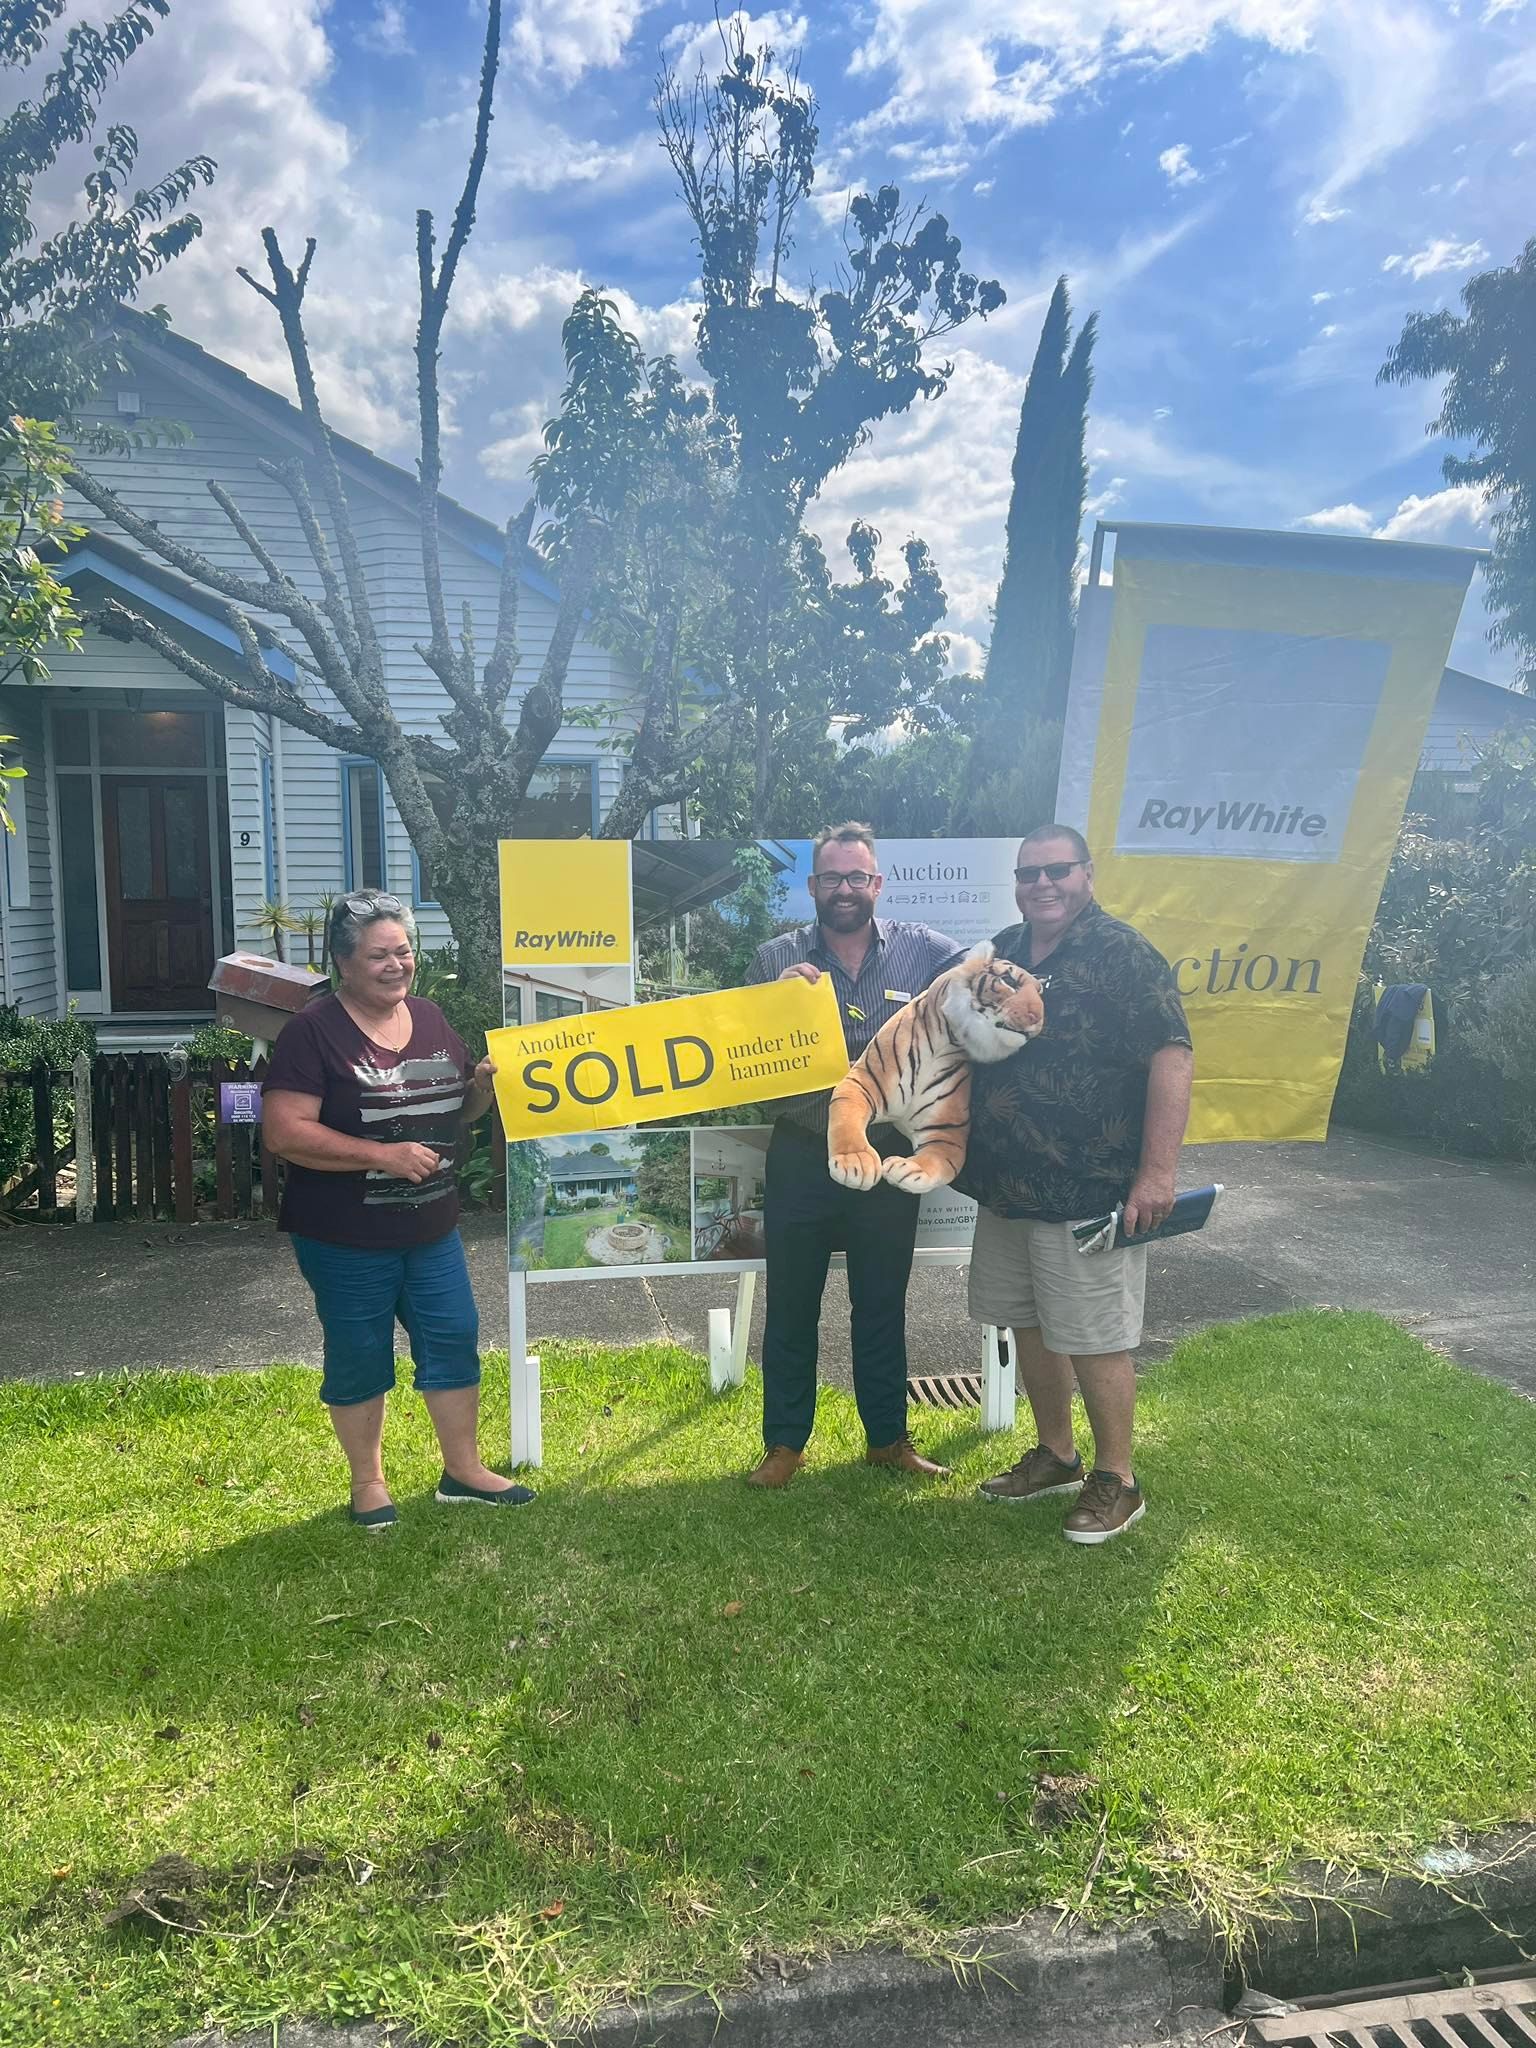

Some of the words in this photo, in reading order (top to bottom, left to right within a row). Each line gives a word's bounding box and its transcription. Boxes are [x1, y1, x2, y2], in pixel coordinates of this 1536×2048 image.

[1138, 799, 1327, 837] RayWhite
[240, 832, 250, 846] 9
[887, 862, 969, 881] Auction
[886, 895, 894, 905] 4
[911, 895, 918, 905] 2
[971, 894, 978, 903] 2
[514, 930, 617, 950] RayWhite
[1172, 943, 1322, 996] ction
[515, 1030, 596, 1057] Another
[727, 1036, 783, 1061] under
[789, 1029, 821, 1052] the
[522, 1035, 715, 1114] SOLD
[729, 1054, 811, 1081] hammer
[918, 1215, 977, 1226] bay.co.nz/GBY
